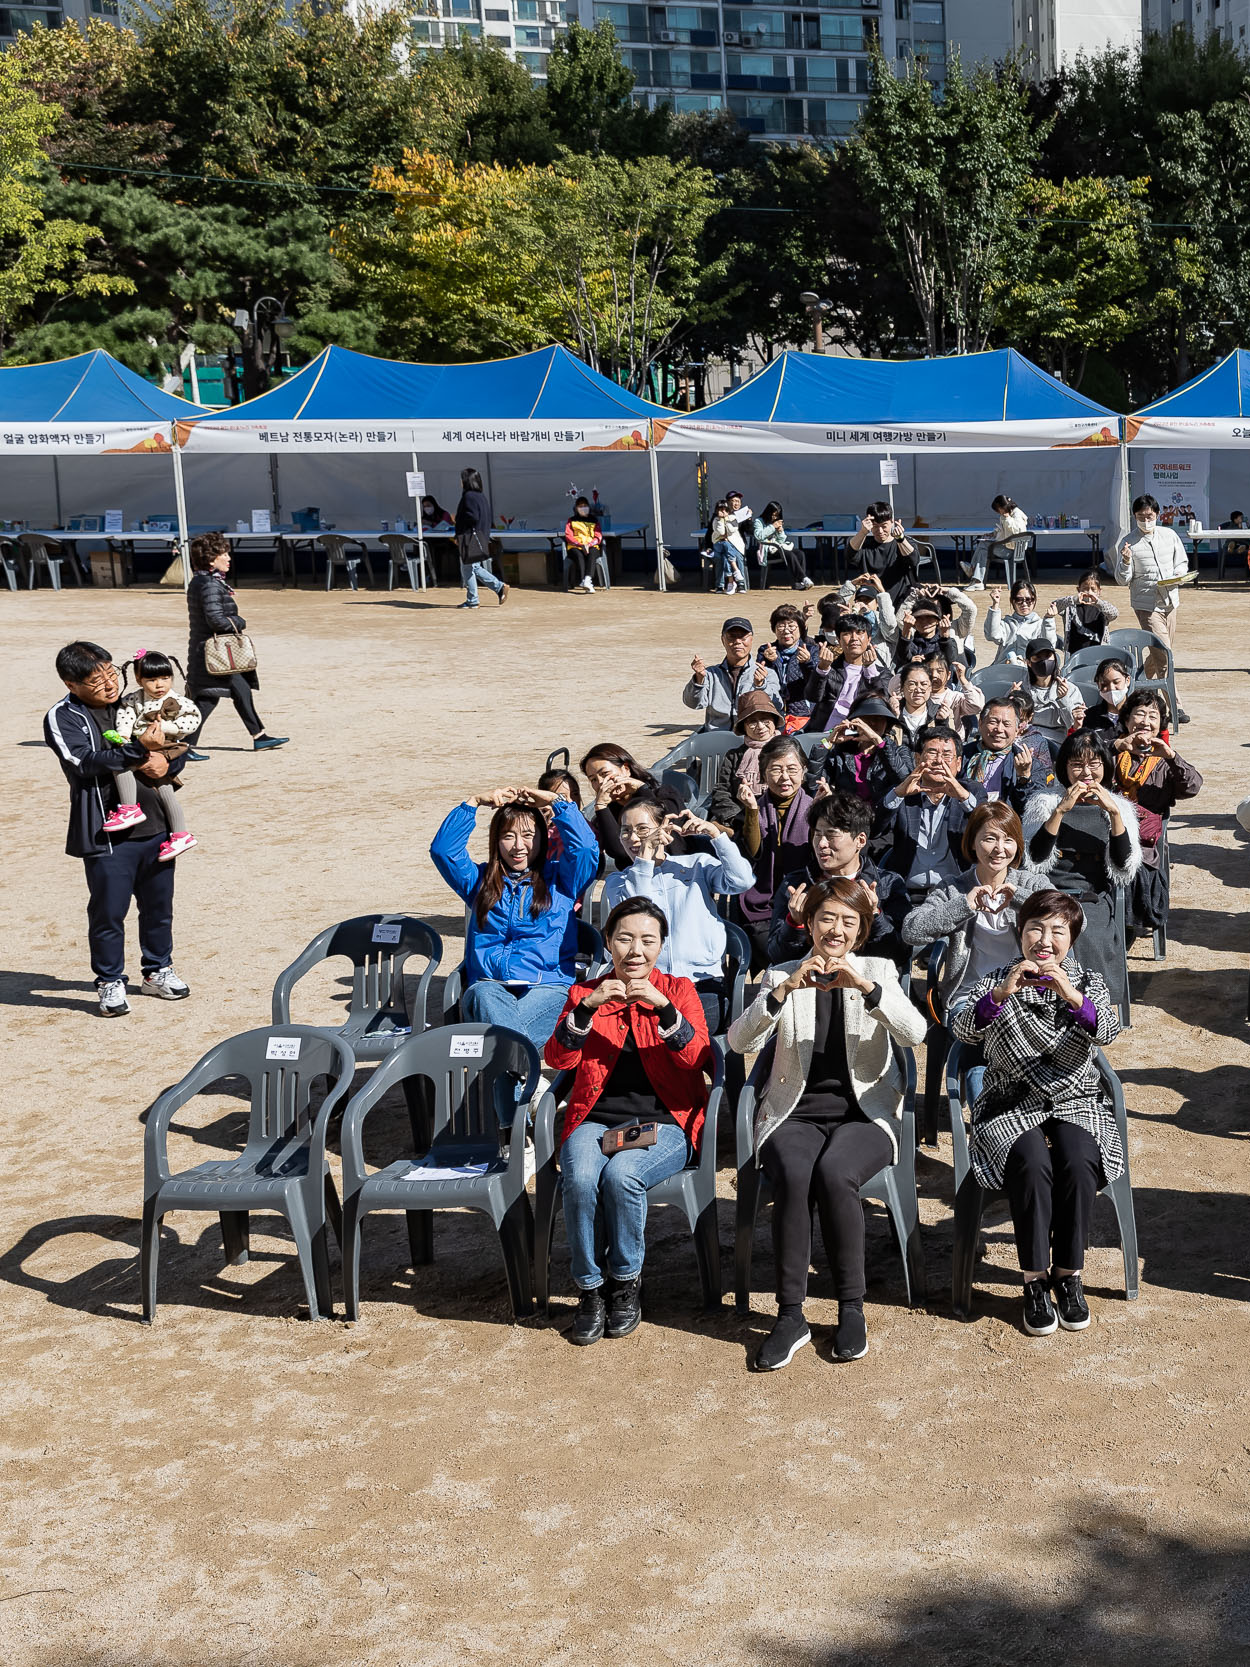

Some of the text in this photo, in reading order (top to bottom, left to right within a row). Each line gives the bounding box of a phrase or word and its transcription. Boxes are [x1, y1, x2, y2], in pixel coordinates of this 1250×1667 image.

[3, 433, 105, 444] 얼굴 압화액자 만들기
[258, 431, 397, 443] 베트남 전통모자(논라) 만들기
[442, 430, 585, 442] 세계 여러나라 바람개비 만들기
[826, 431, 947, 442] 미니 세계 여행가방 만들기
